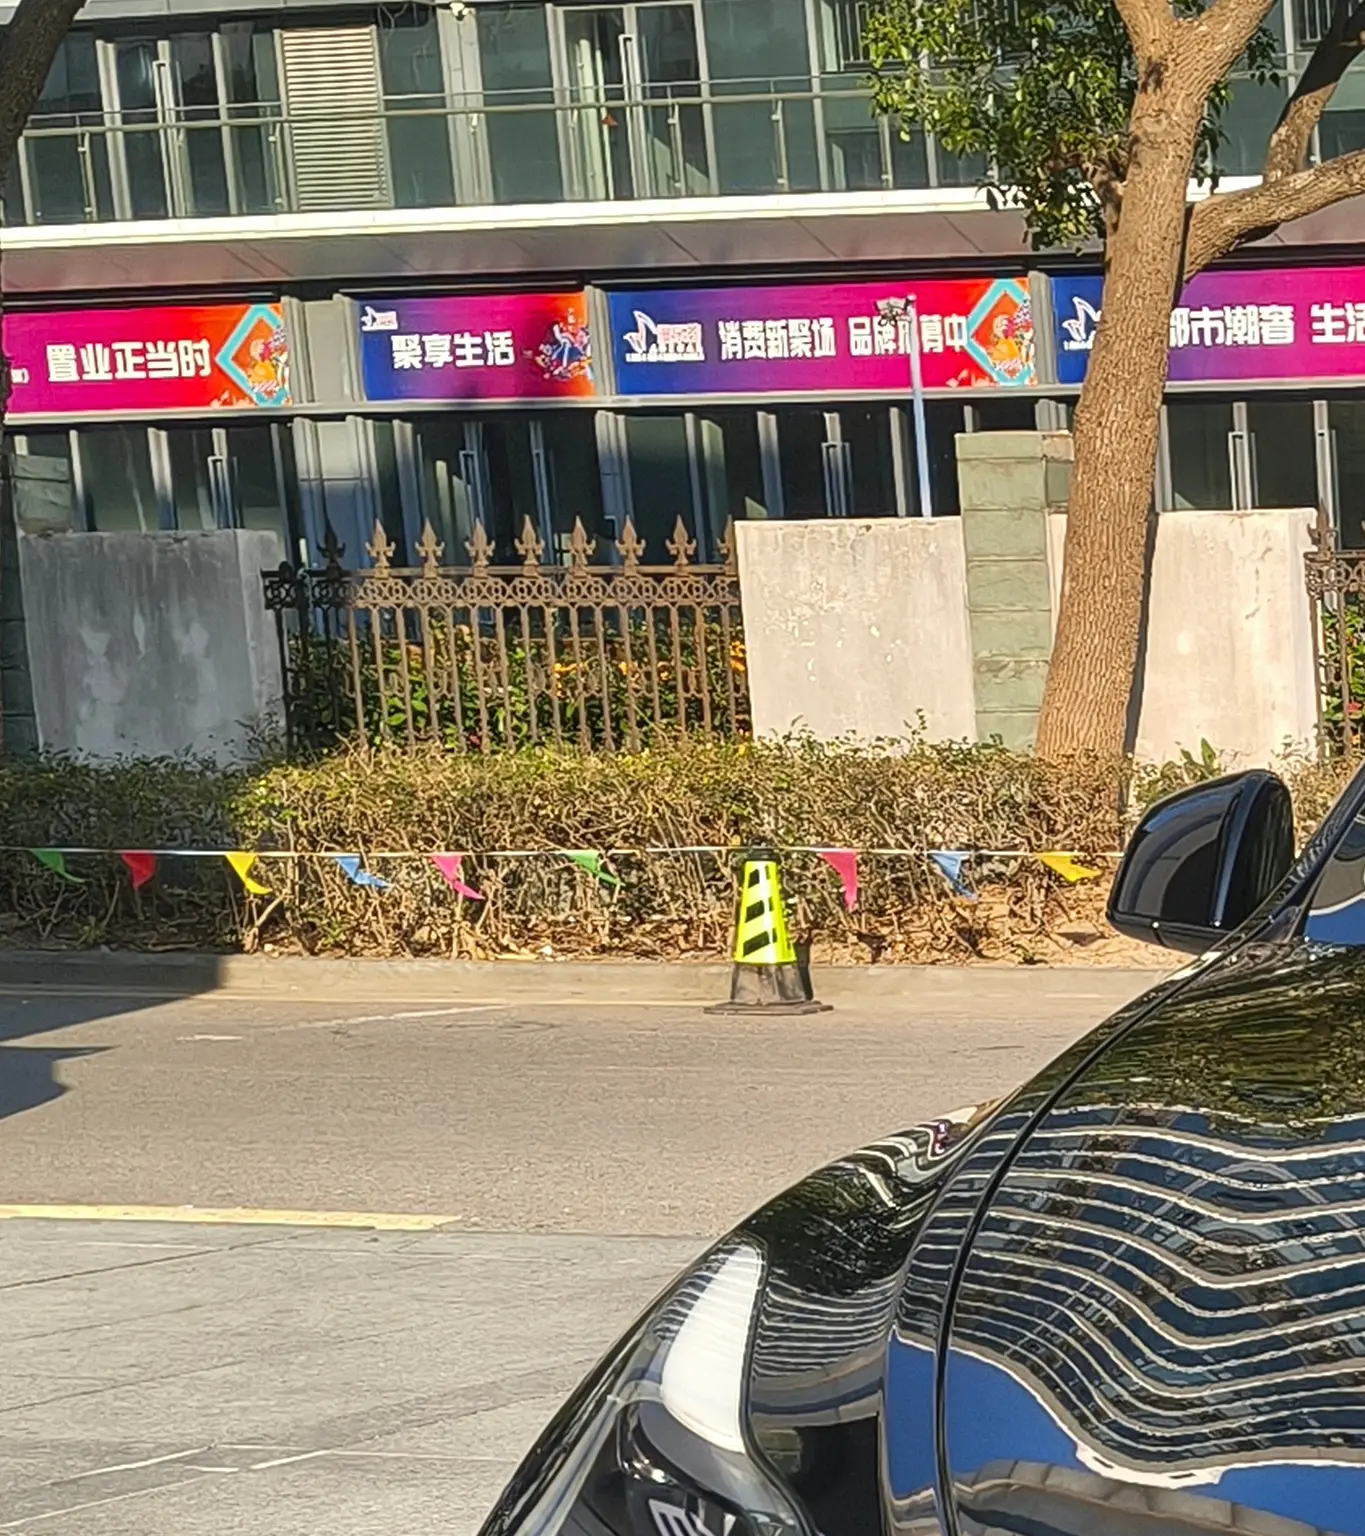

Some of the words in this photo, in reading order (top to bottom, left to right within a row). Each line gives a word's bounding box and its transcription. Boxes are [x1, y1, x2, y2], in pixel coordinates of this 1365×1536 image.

[46, 338, 211, 382] 置业正当时
[390, 330, 516, 369] 聚享生活
[718, 317, 837, 360] 消费新聚场
